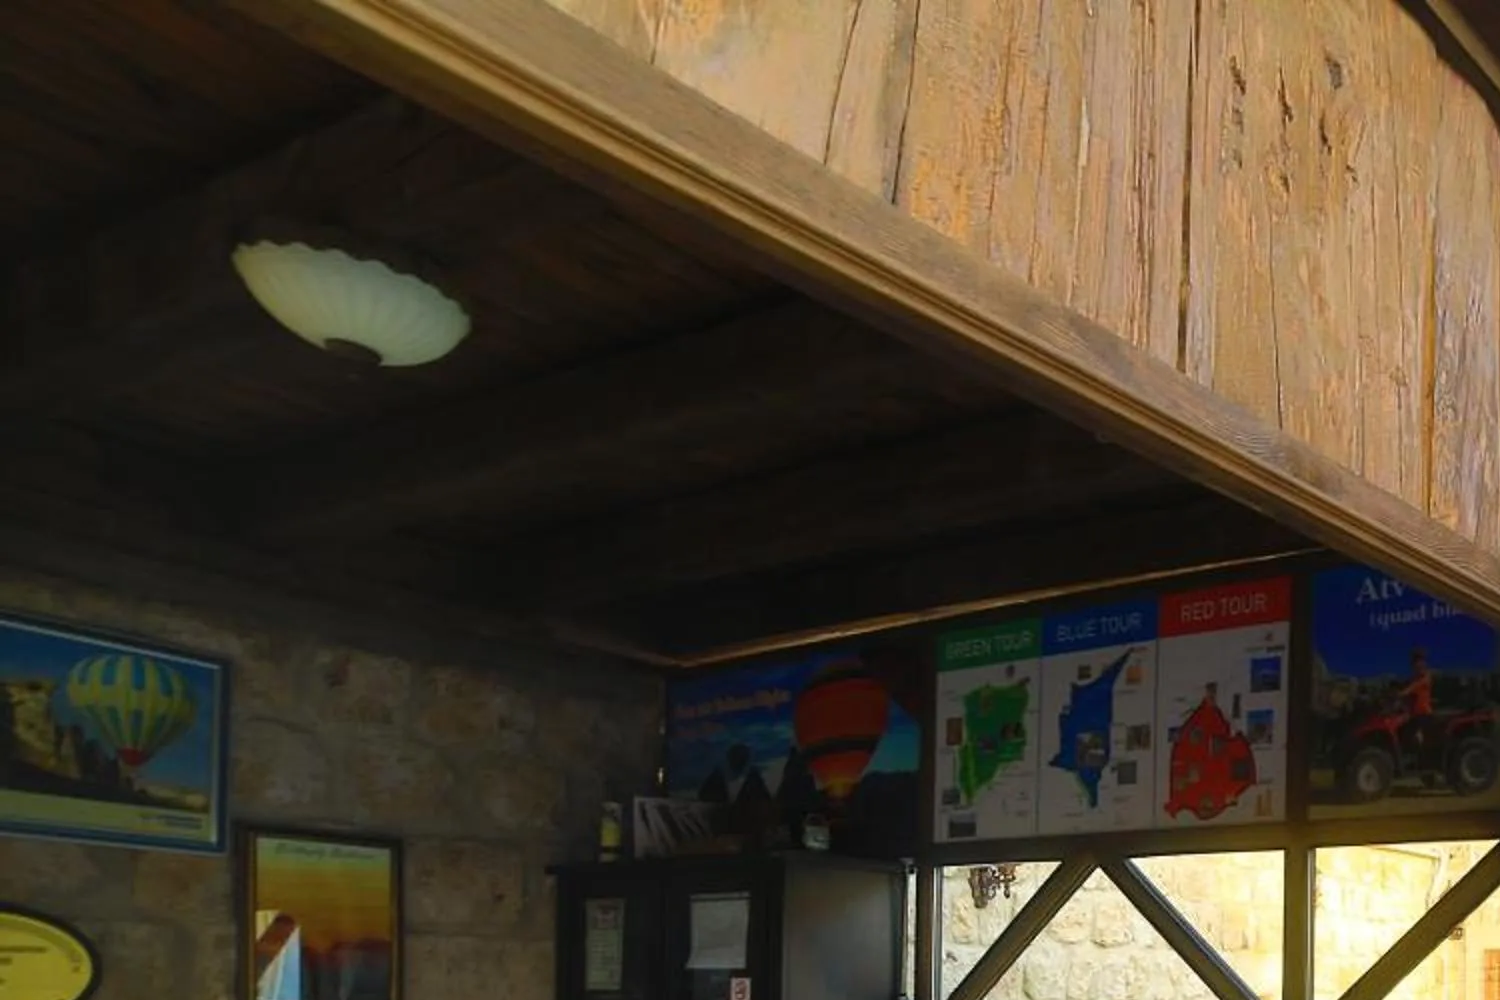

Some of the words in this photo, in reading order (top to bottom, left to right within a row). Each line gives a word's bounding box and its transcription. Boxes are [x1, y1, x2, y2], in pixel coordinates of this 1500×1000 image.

[1180, 599, 1215, 623] RED
[1218, 593, 1268, 618] TOUR
[1056, 618, 1097, 644] BLUE
[1099, 611, 1144, 637] TOUR
[945, 638, 992, 661] GREEN
[995, 630, 1033, 656] TOUR
